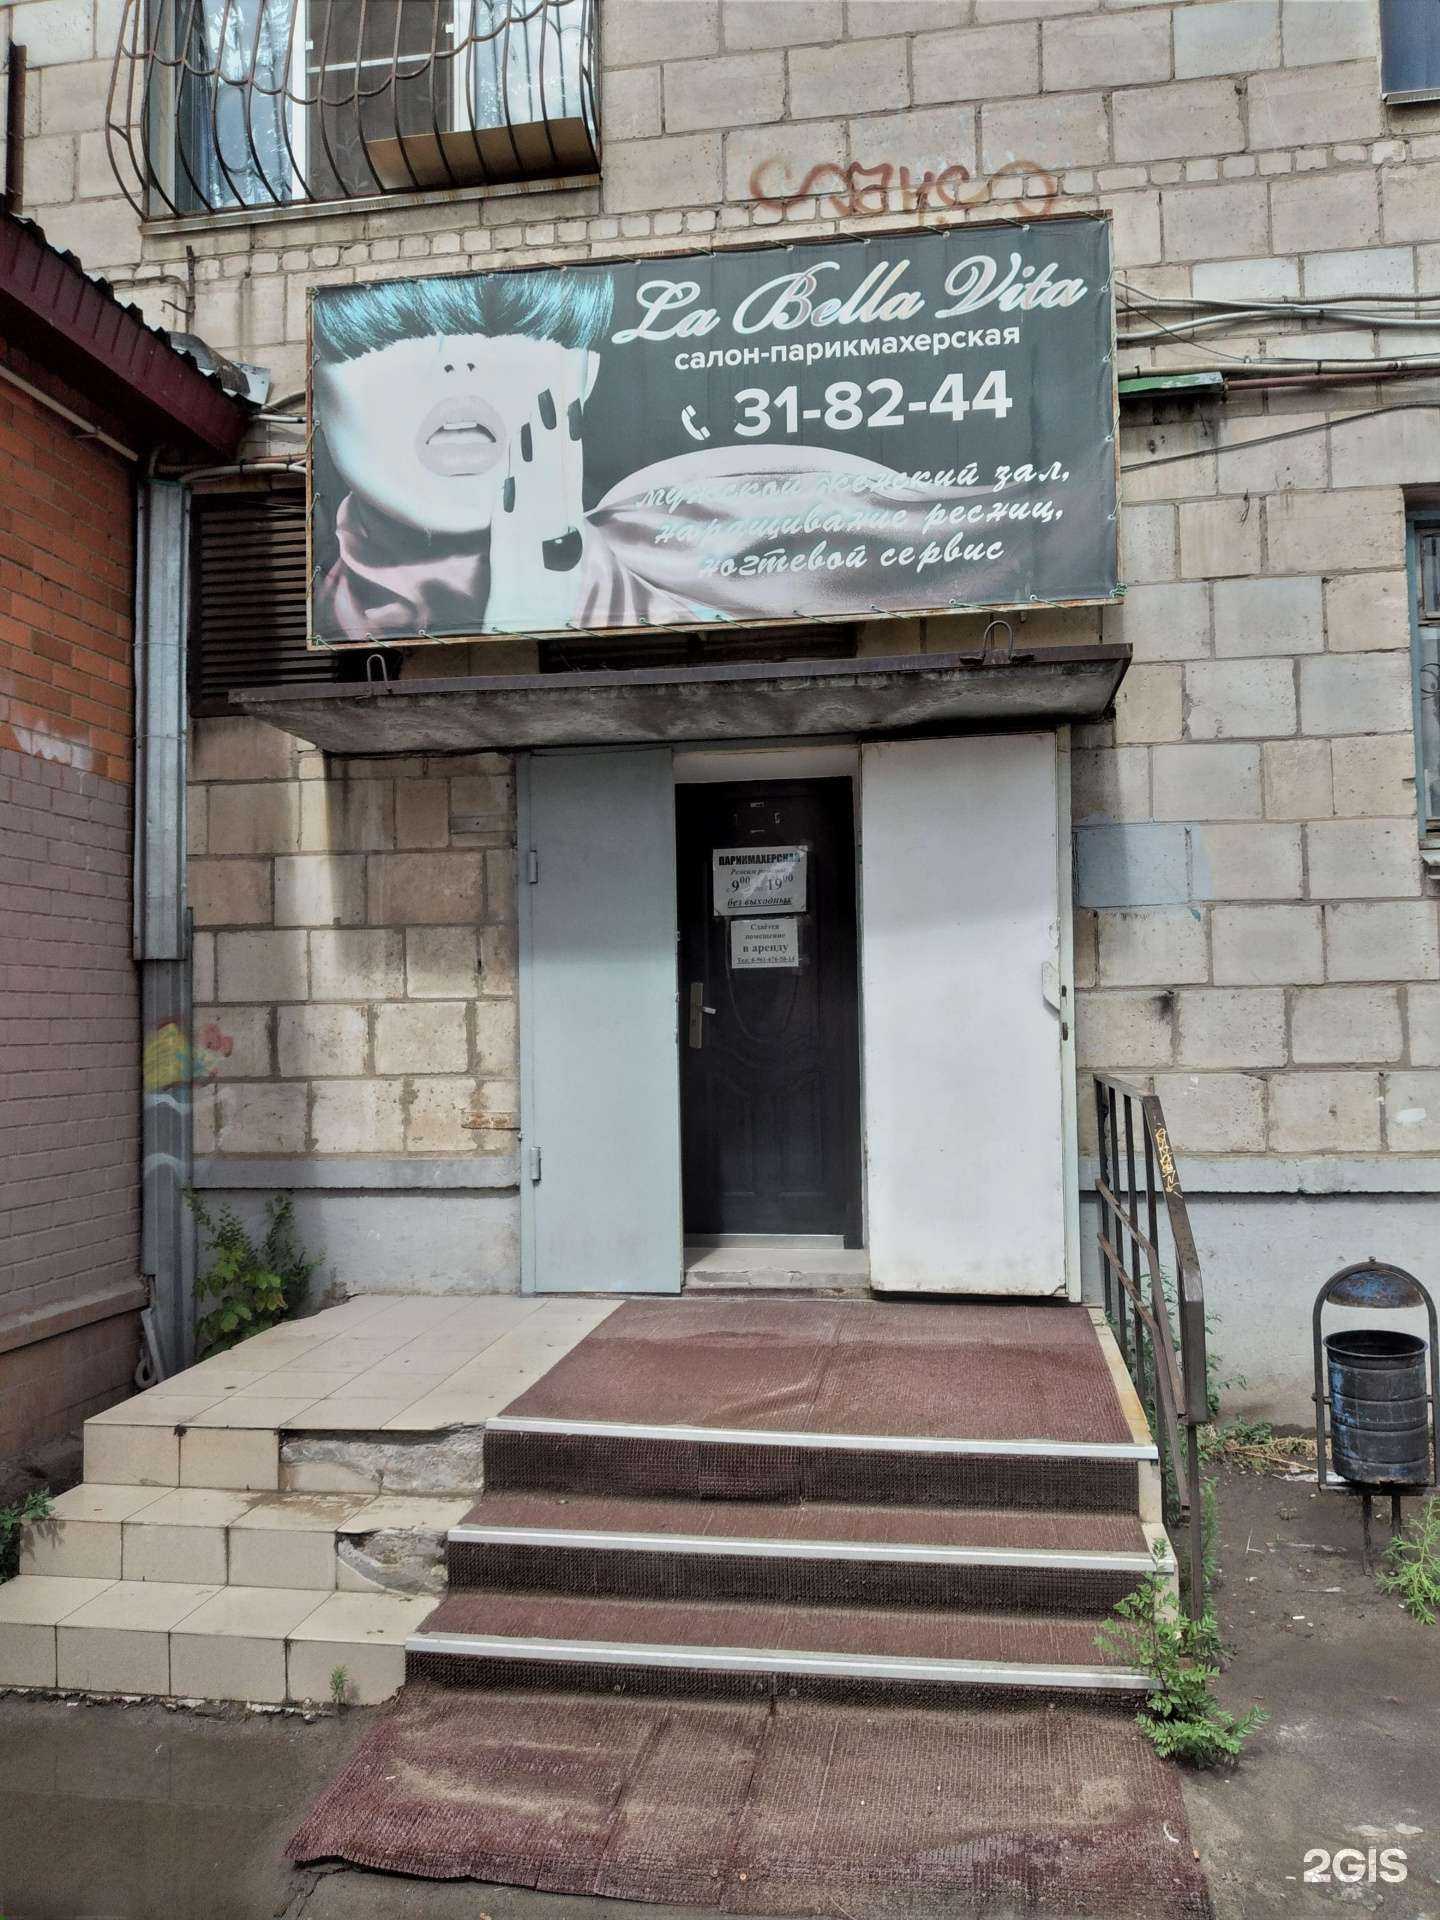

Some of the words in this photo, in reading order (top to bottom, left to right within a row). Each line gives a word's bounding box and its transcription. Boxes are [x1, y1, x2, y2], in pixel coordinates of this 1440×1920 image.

[613, 279, 720, 345] La
[732, 259, 926, 336] Bella
[934, 252, 1089, 320] Vita
[674, 326, 1021, 371] салон-парикмахерская
[733, 370, 1014, 438] 31-82-44
[993, 461, 1070, 497] зал,
[924, 498, 1064, 533] ресниц,
[699, 535, 868, 578] ногтевой
[879, 531, 1006, 574] сервис
